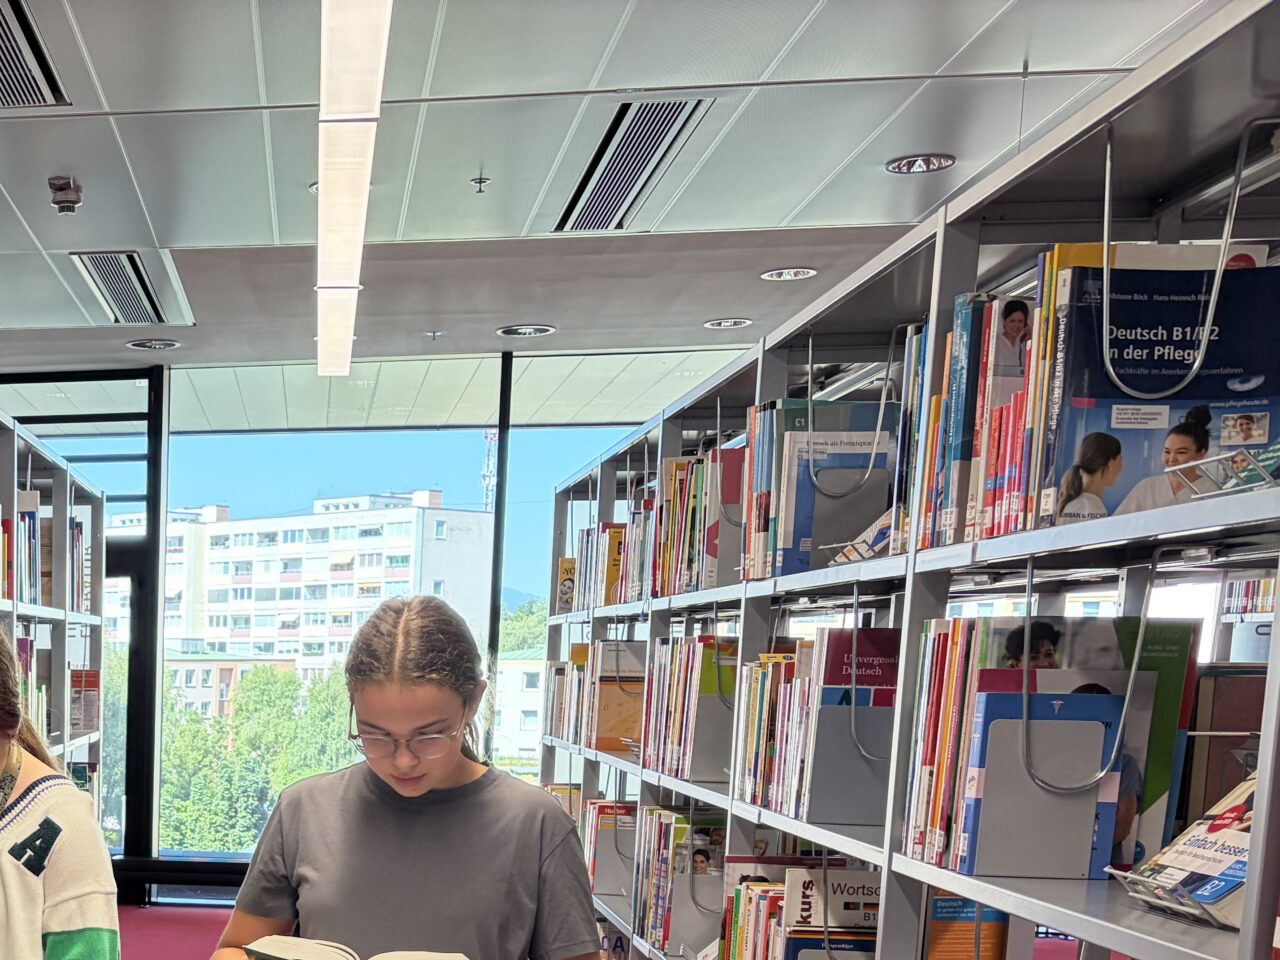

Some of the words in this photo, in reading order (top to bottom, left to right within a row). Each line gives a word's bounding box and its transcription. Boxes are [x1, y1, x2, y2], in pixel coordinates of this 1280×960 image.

[1108, 326, 1168, 340] Deutsch
[1123, 347, 1147, 360] der
[795, 418, 805, 426] C1
[844, 654, 898, 665] Uvergessl
[842, 666, 882, 675] Dutsch
[7, 817, 64, 877] A
[832, 882, 881, 896] Wortsc
[863, 913, 877, 921] B1
